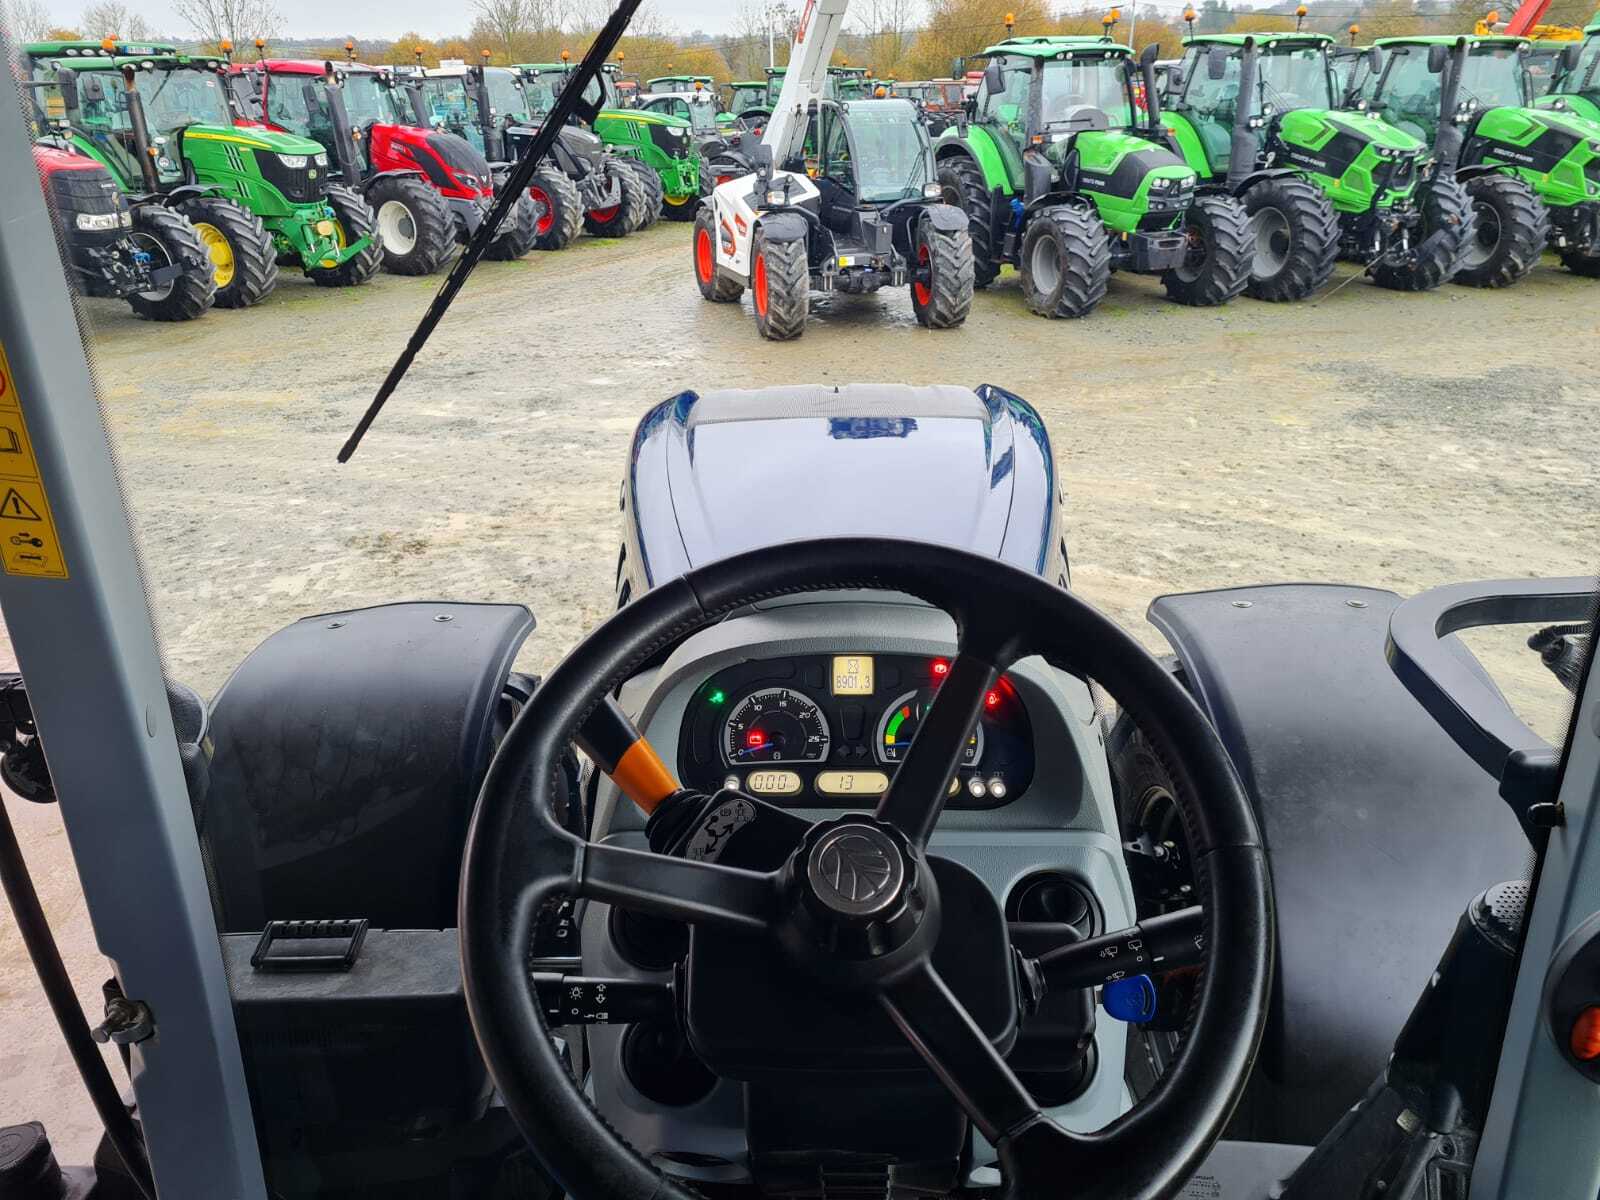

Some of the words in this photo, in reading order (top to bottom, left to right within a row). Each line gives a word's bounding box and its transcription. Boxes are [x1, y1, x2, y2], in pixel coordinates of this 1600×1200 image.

[754, 704, 763, 712] 10
[779, 700, 788, 708] 15
[799, 711, 811, 719] 20
[808, 735, 820, 743] 25
[839, 775, 854, 791] 13
